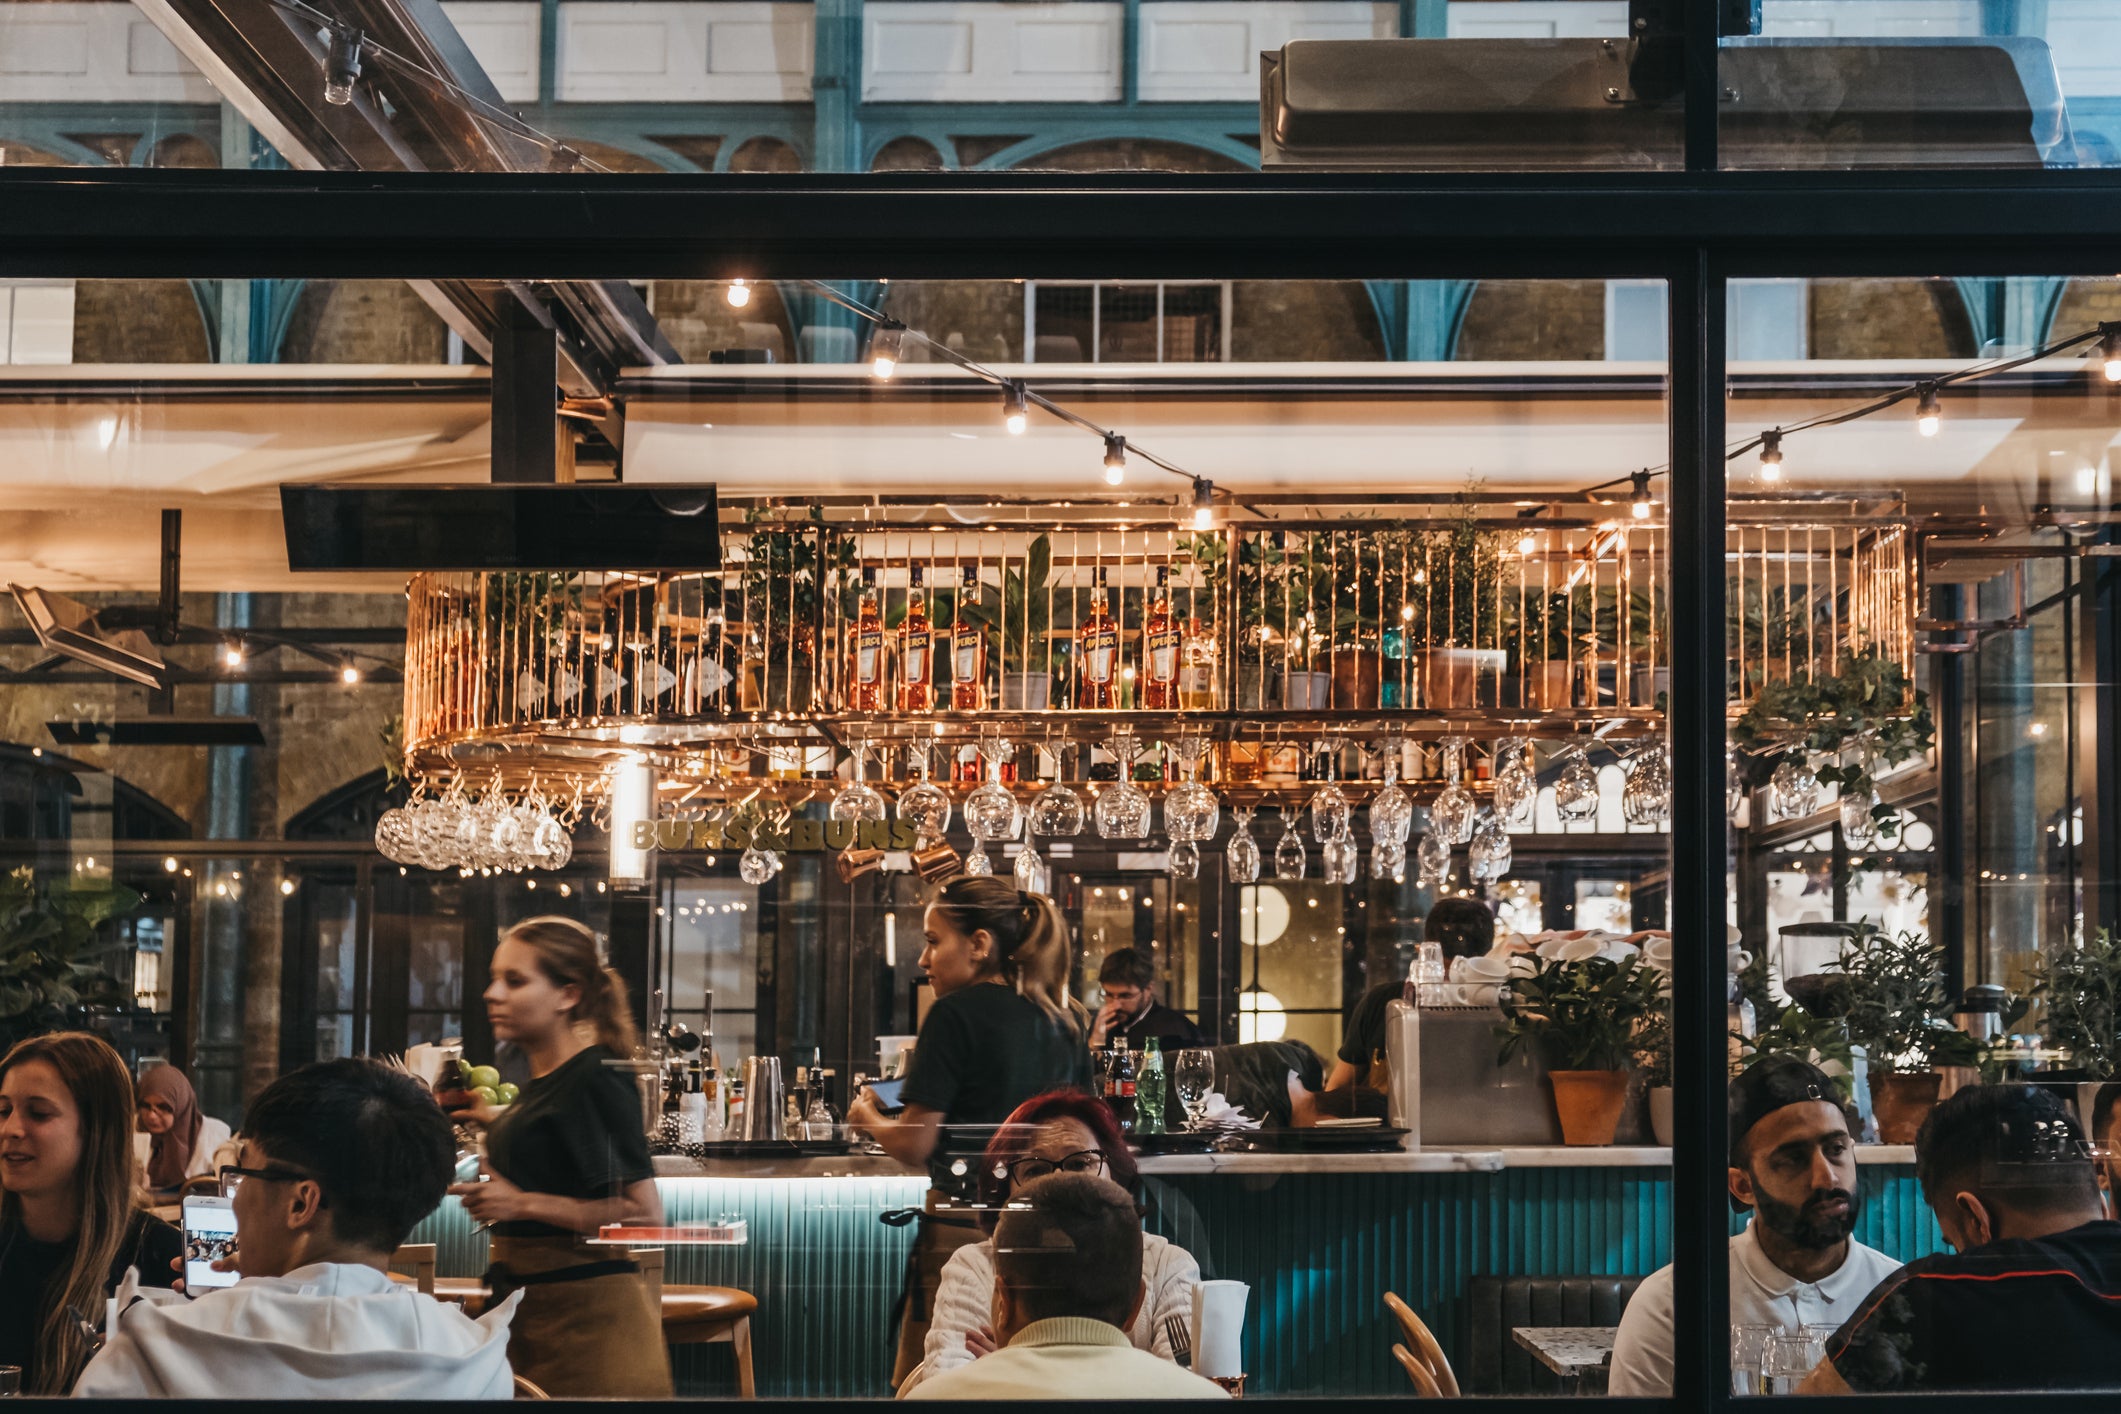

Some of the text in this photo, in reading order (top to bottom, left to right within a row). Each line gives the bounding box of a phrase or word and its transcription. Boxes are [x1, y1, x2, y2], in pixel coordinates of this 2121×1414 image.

[852, 636, 881, 650] EROL
[901, 636, 928, 650] EROL
[953, 635, 980, 649] PERO
[1085, 635, 1114, 650] APROL
